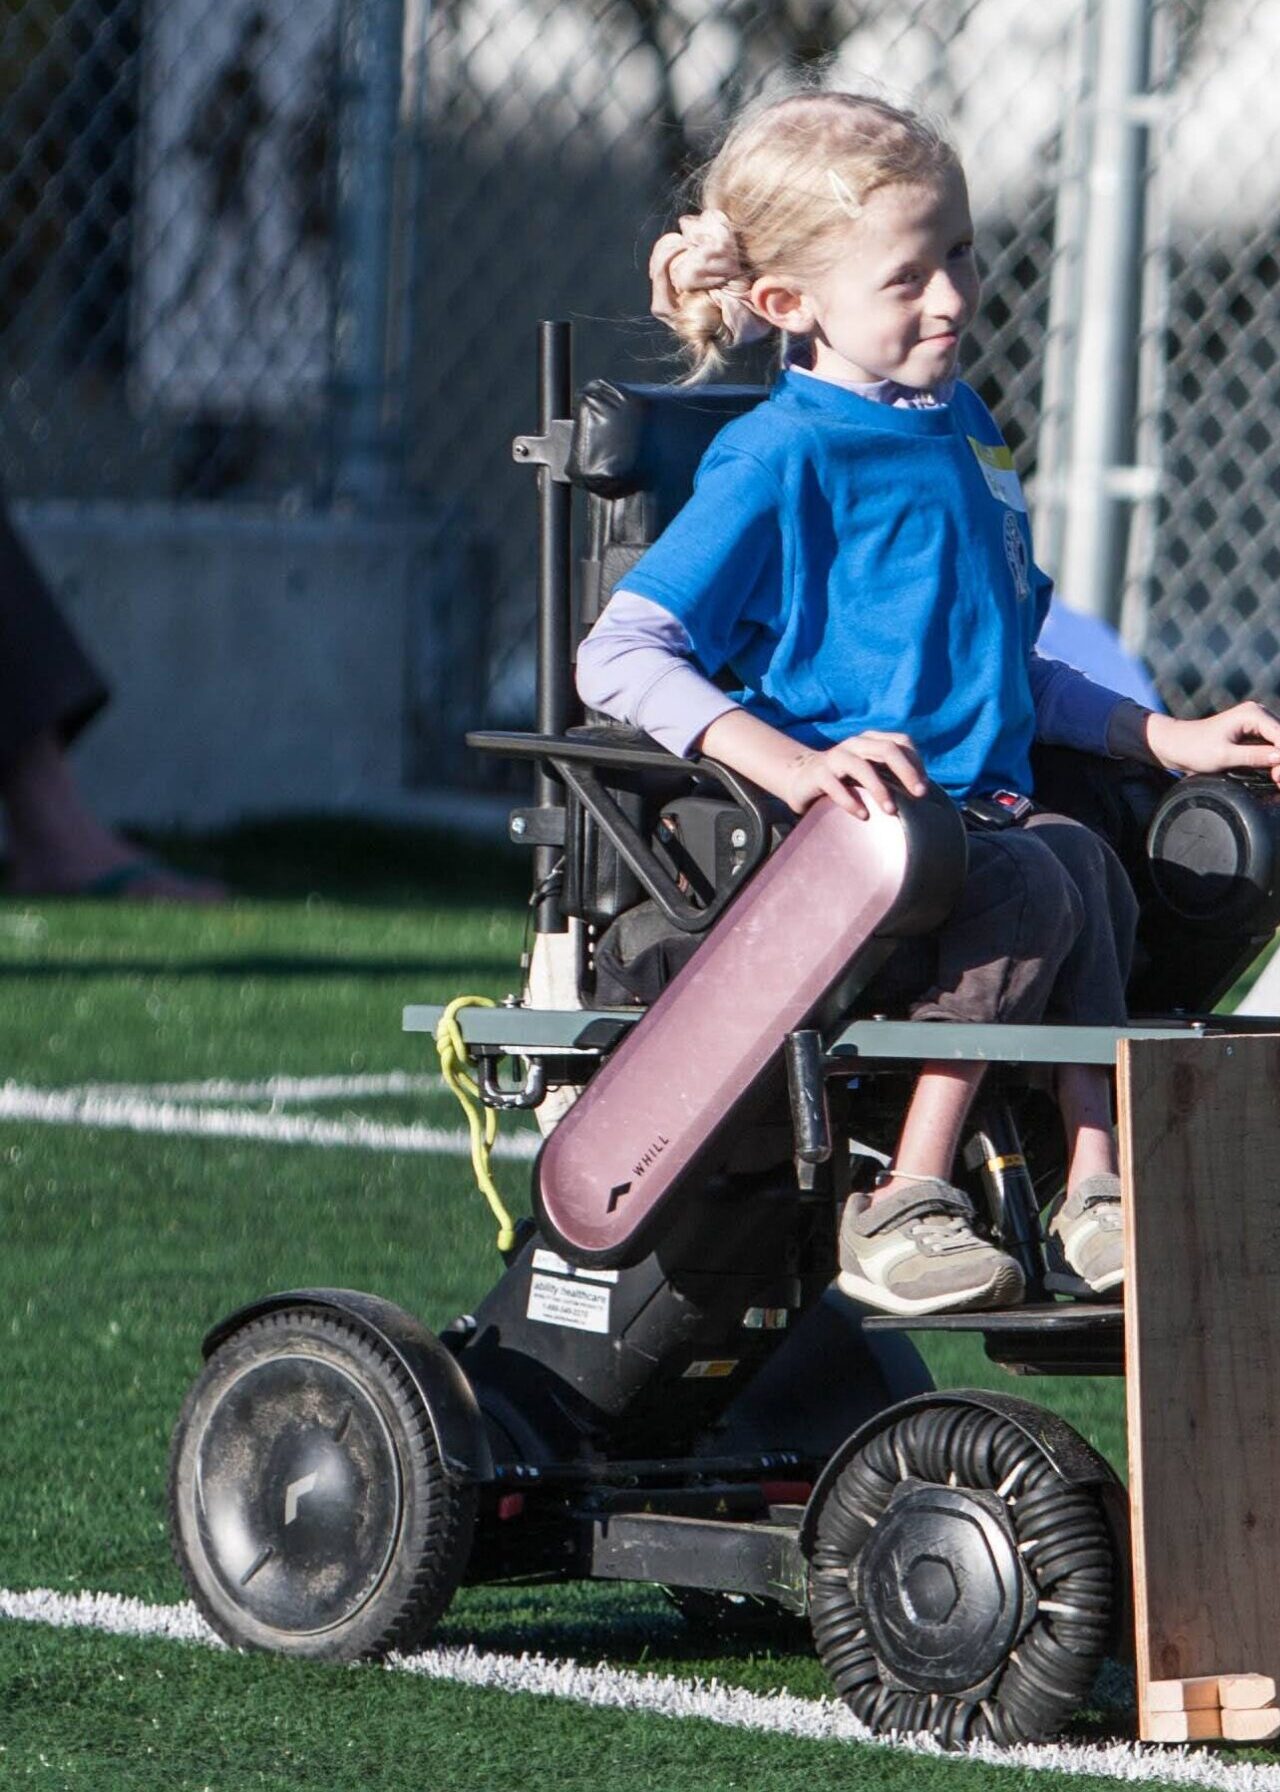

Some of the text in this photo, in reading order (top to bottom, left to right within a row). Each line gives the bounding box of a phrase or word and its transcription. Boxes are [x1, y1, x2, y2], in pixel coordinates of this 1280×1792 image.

[632, 1135, 670, 1176] WHILL
[534, 1282, 558, 1295] ability
[560, 1287, 607, 1304] healthcare
